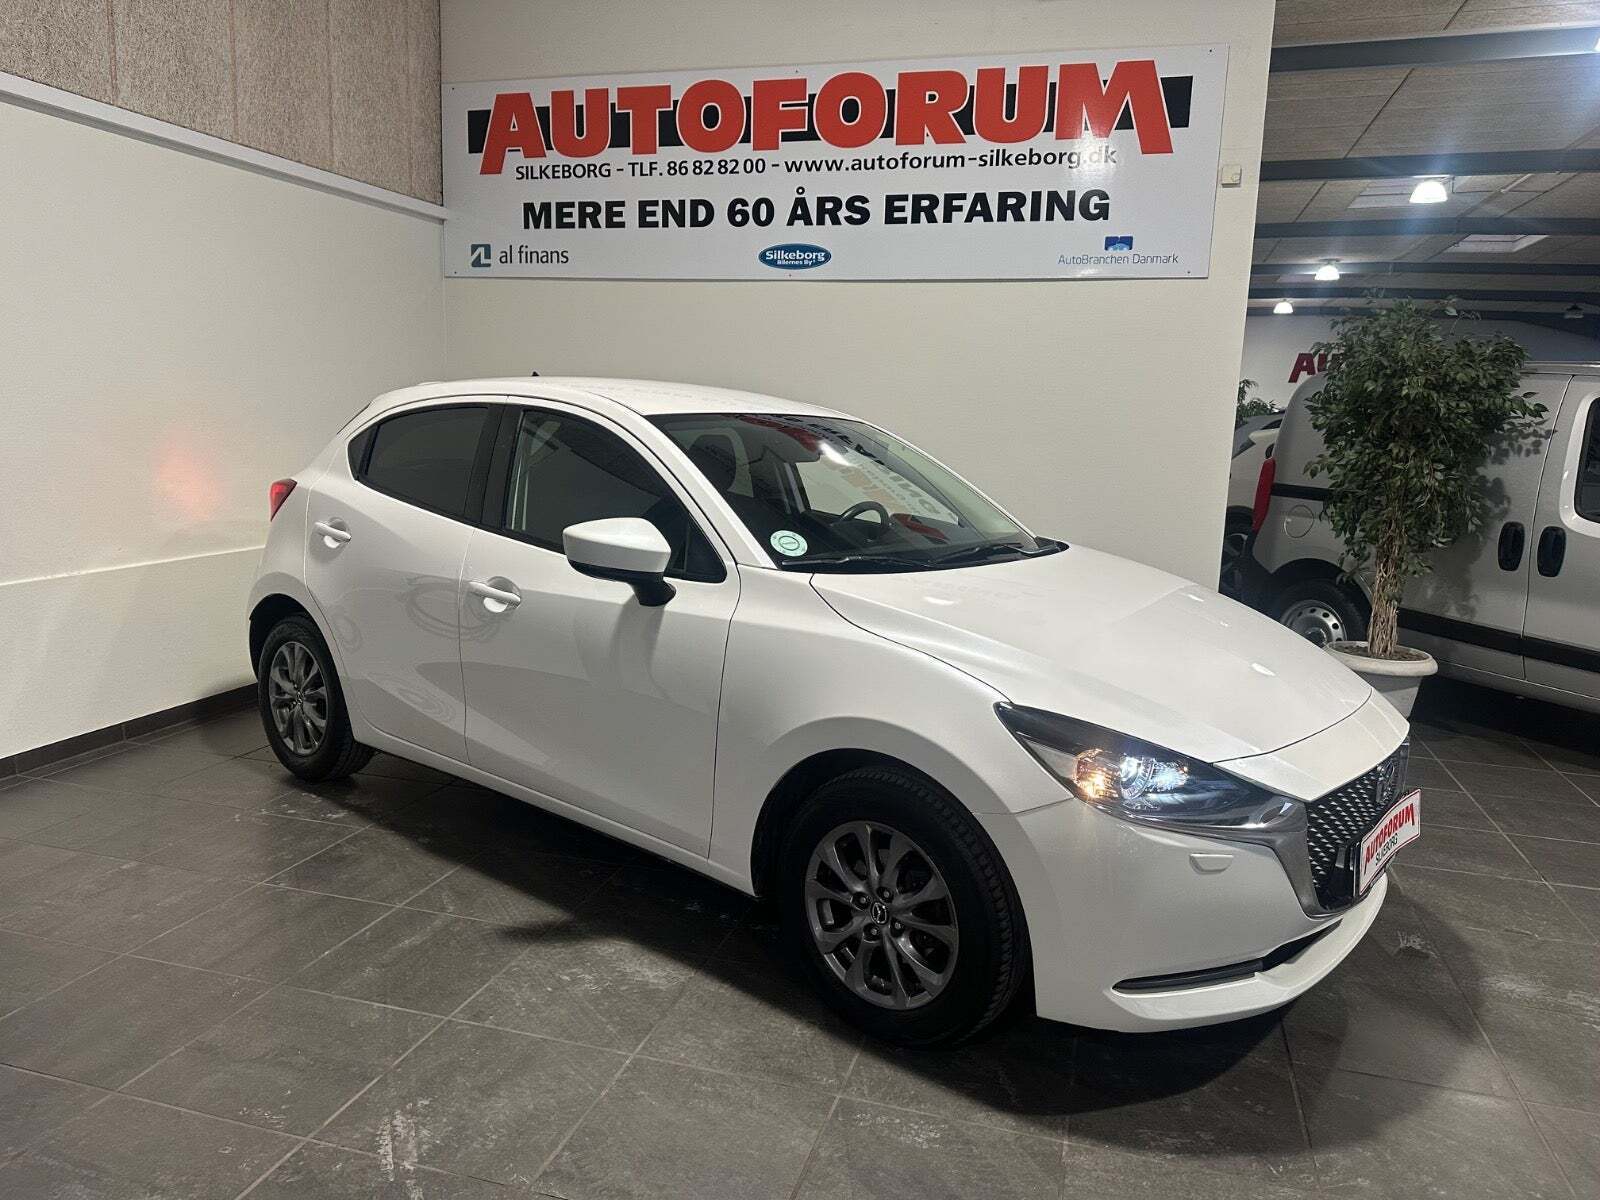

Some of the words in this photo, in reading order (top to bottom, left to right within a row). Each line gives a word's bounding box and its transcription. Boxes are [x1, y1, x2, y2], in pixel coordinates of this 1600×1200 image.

[480, 60, 1174, 175] AUTOFORUM
[516, 163, 612, 180] SILKEBORG
[628, 160, 663, 177] TLF.
[785, 147, 1118, 173] www.autoforum-silkeborg.dk
[523, 201, 626, 230] MERE
[638, 199, 715, 229] END
[727, 198, 775, 228] 60
[786, 186, 871, 226] ÅRS
[884, 189, 1111, 225] ERFARING
[499, 244, 513, 264] al
[518, 244, 569, 264] finans
[765, 249, 826, 262] Silkeborg
[1058, 253, 1130, 265] AutoBranchen
[1132, 253, 1179, 264] Danmark
[1363, 802, 1415, 876] AUTOFORUM
